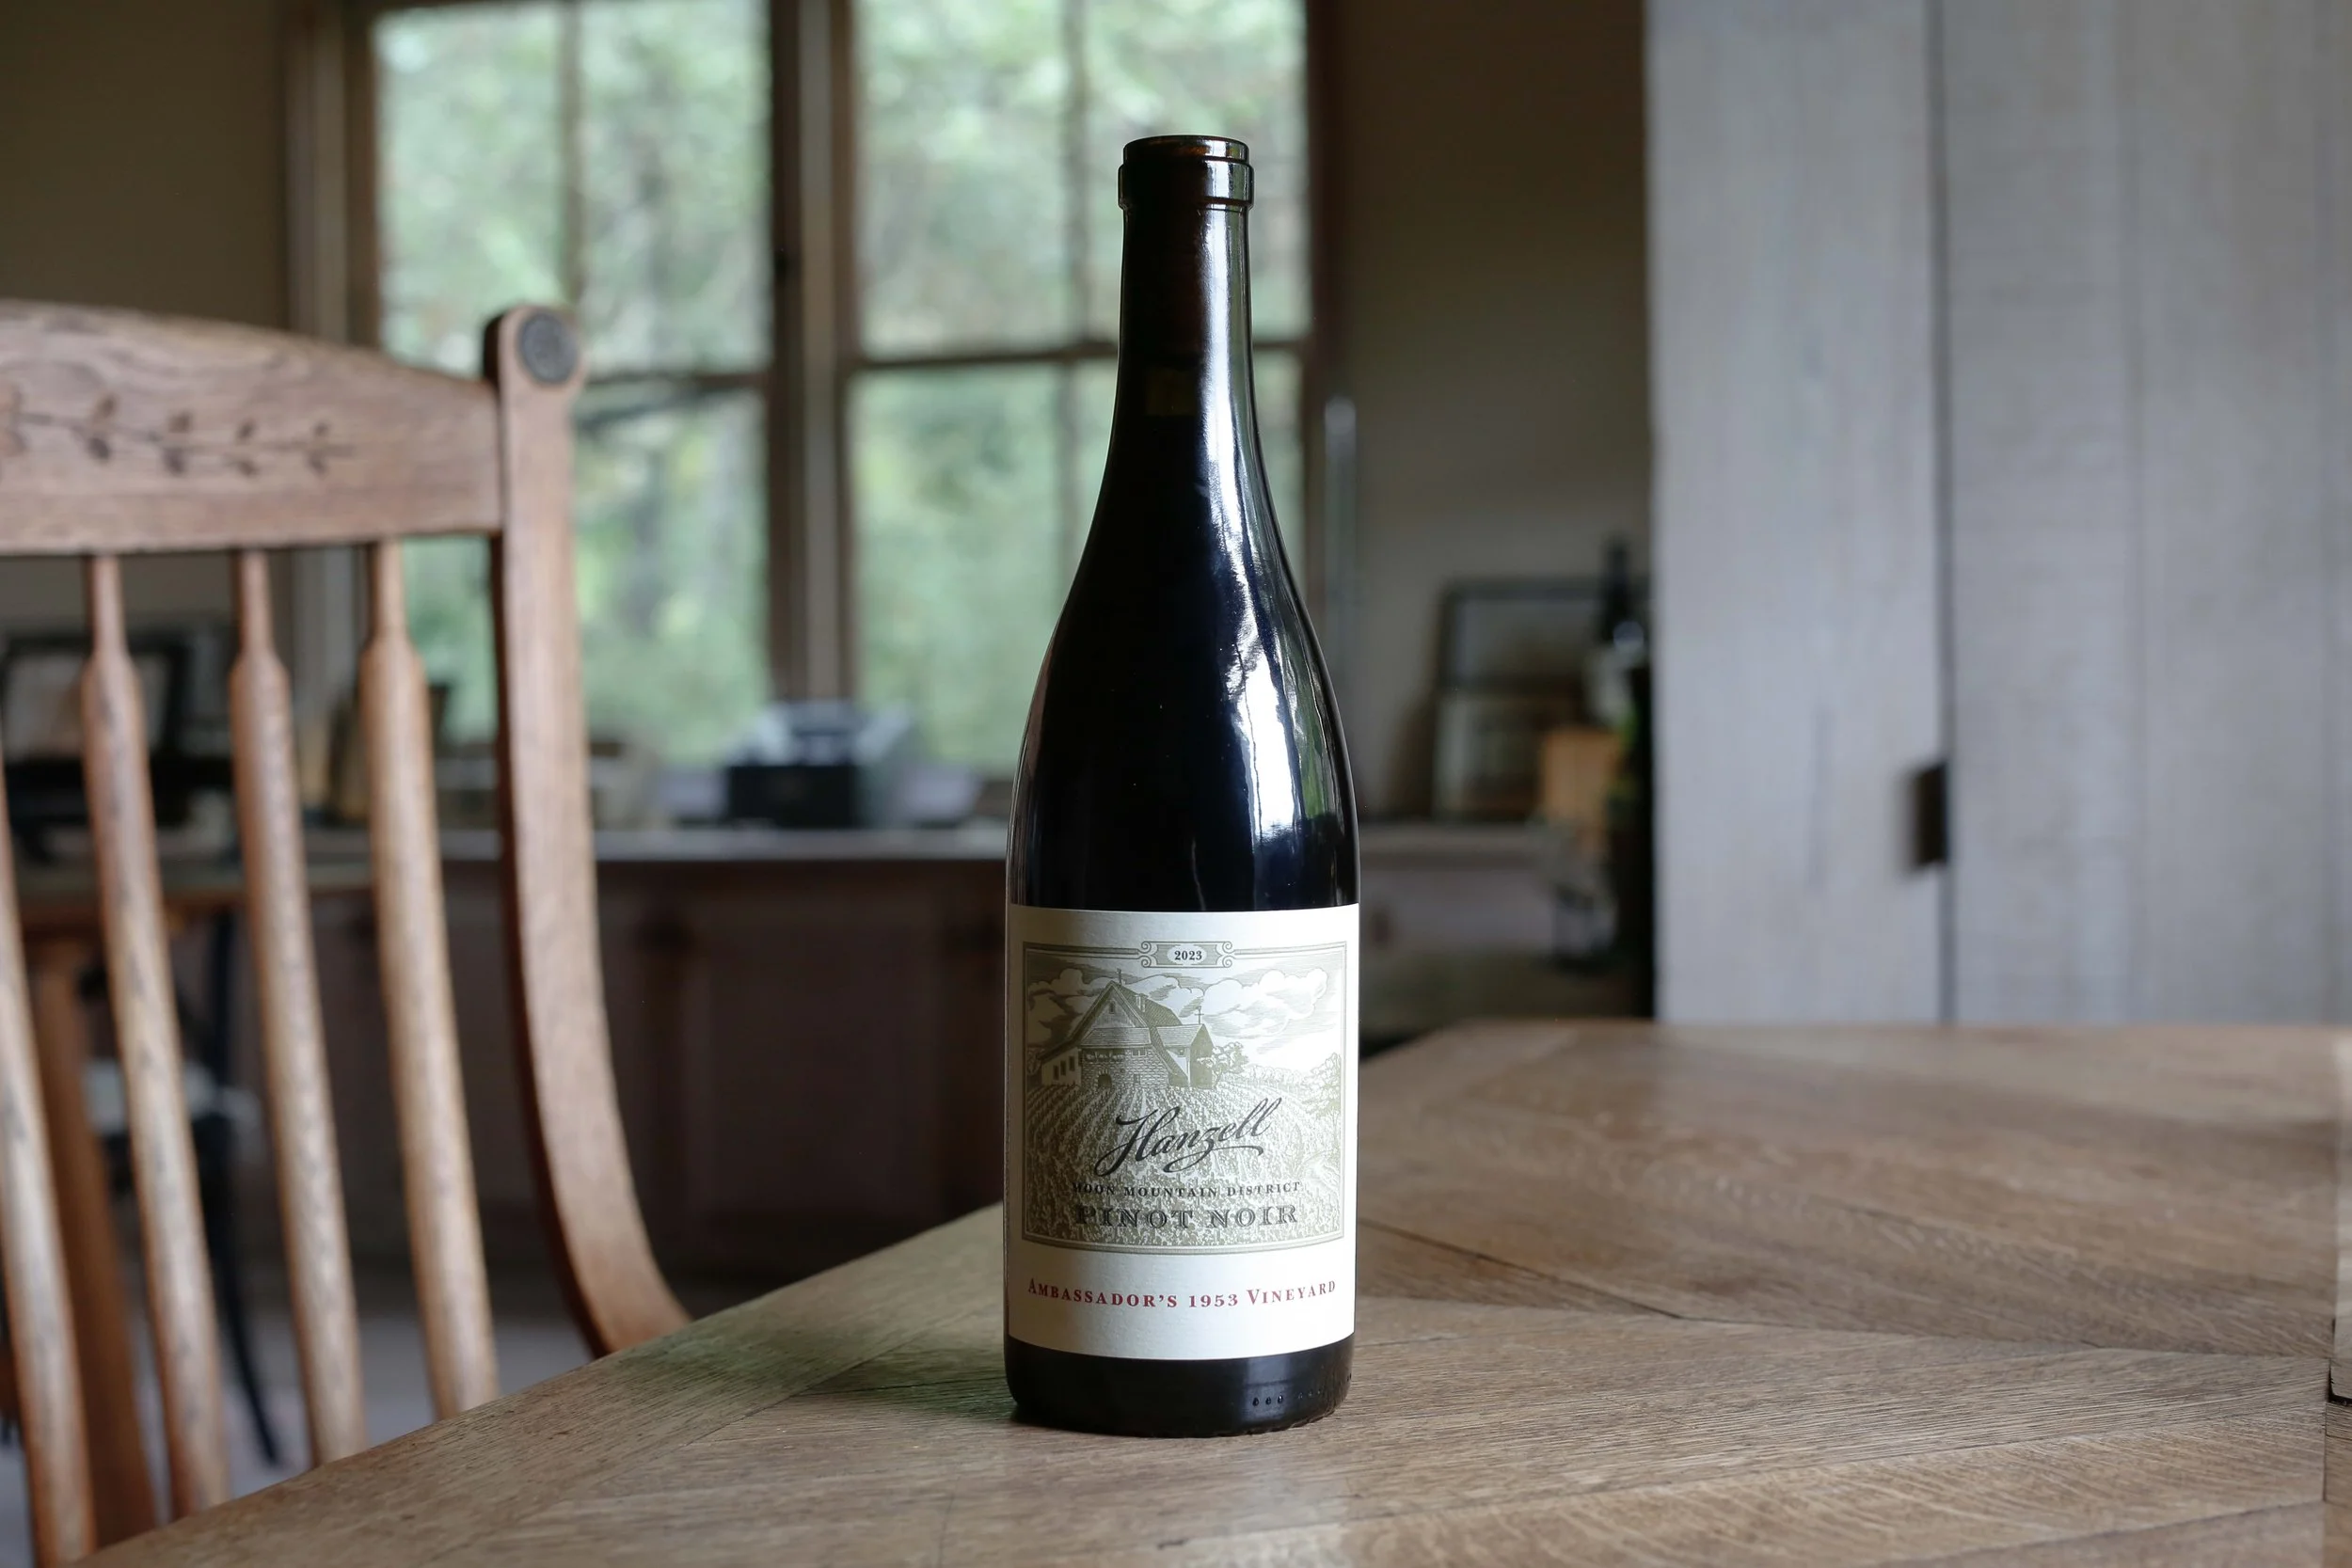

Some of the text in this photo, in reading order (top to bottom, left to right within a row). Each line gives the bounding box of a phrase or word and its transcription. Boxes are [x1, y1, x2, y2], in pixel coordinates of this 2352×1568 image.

[1174, 950, 1202, 960] 2023
[1094, 1097, 1282, 1176] Hanzell
[1072, 1181, 1300, 1197] MOON MOUNTAIN DISTRICT
[1074, 1204, 1298, 1228] PINOT NOIR
[1028, 1277, 1336, 1307] AMBASSADOR'S 1953 VINEYARD
